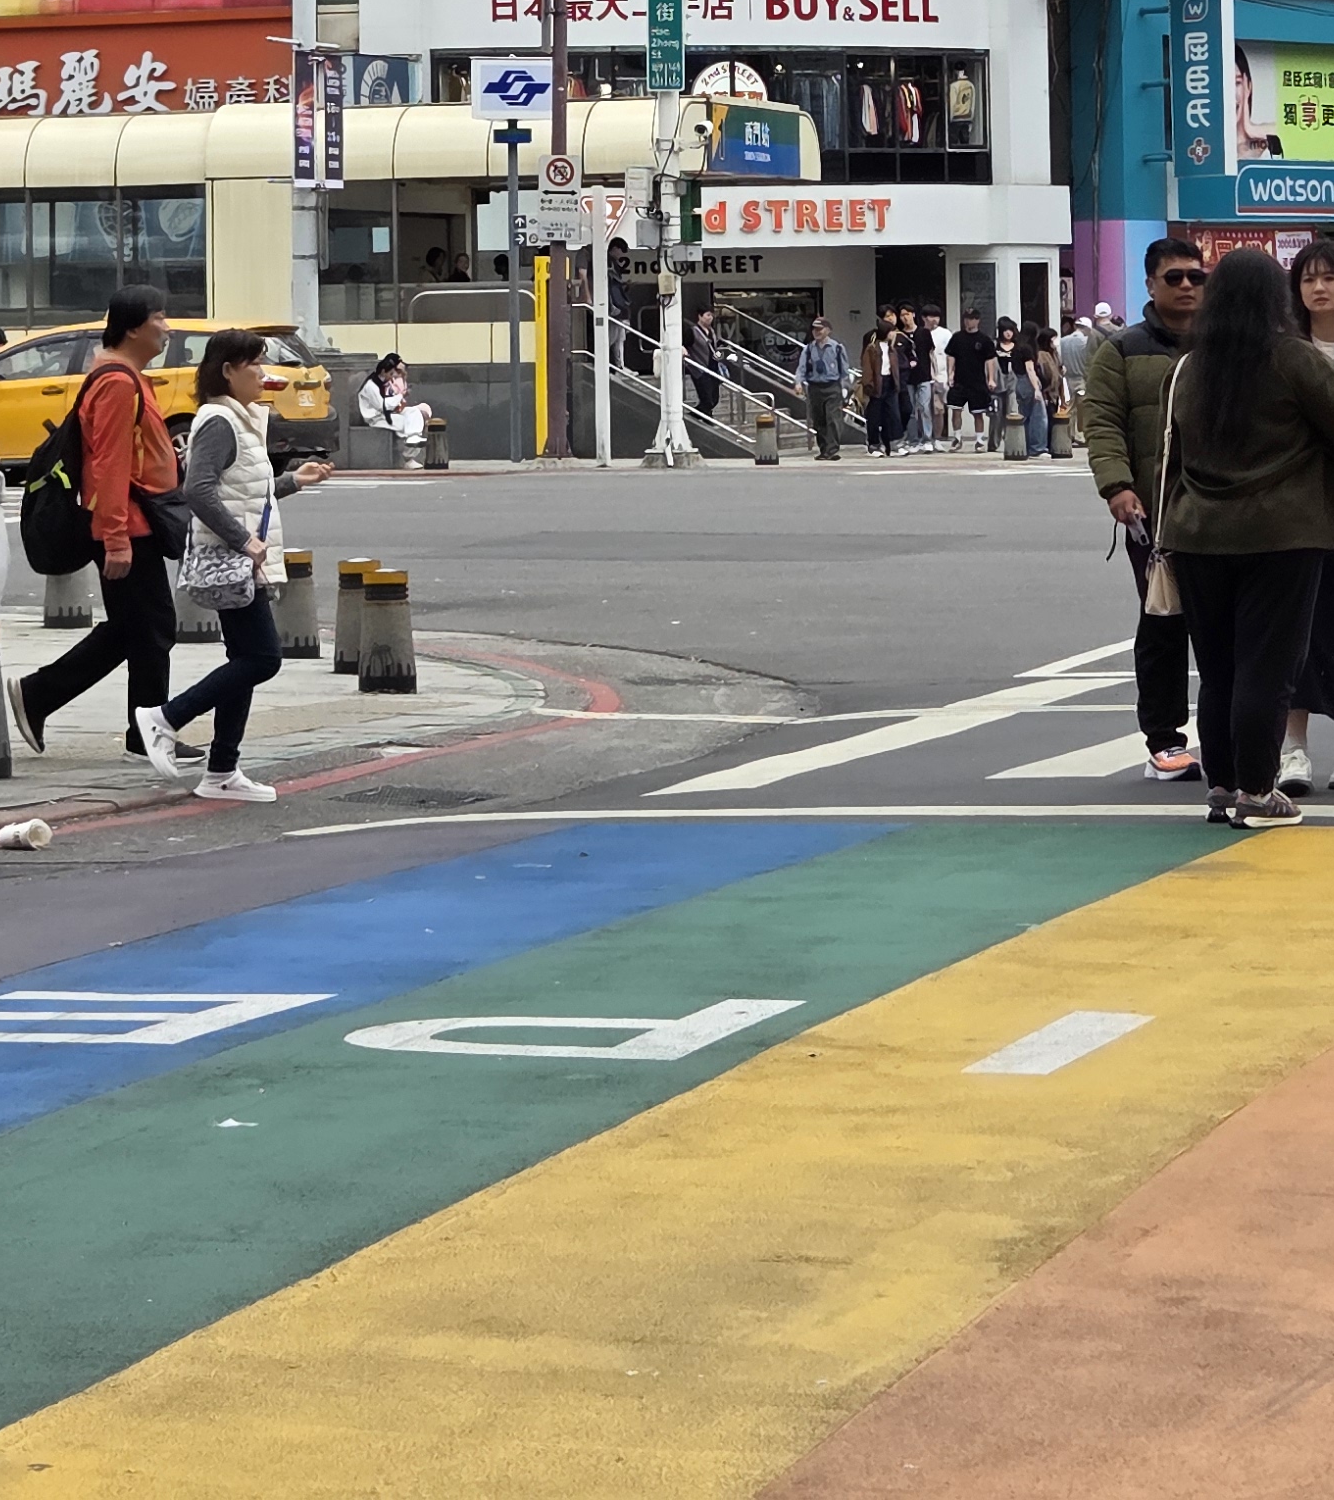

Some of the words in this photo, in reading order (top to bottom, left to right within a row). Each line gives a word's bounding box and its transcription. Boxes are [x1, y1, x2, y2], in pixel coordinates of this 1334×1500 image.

[183, 75, 294, 111] 婦產科
[1184, 31, 1211, 129] 屈臣氏
[740, 198, 892, 234] STREET
[673, 254, 763, 275] REET
